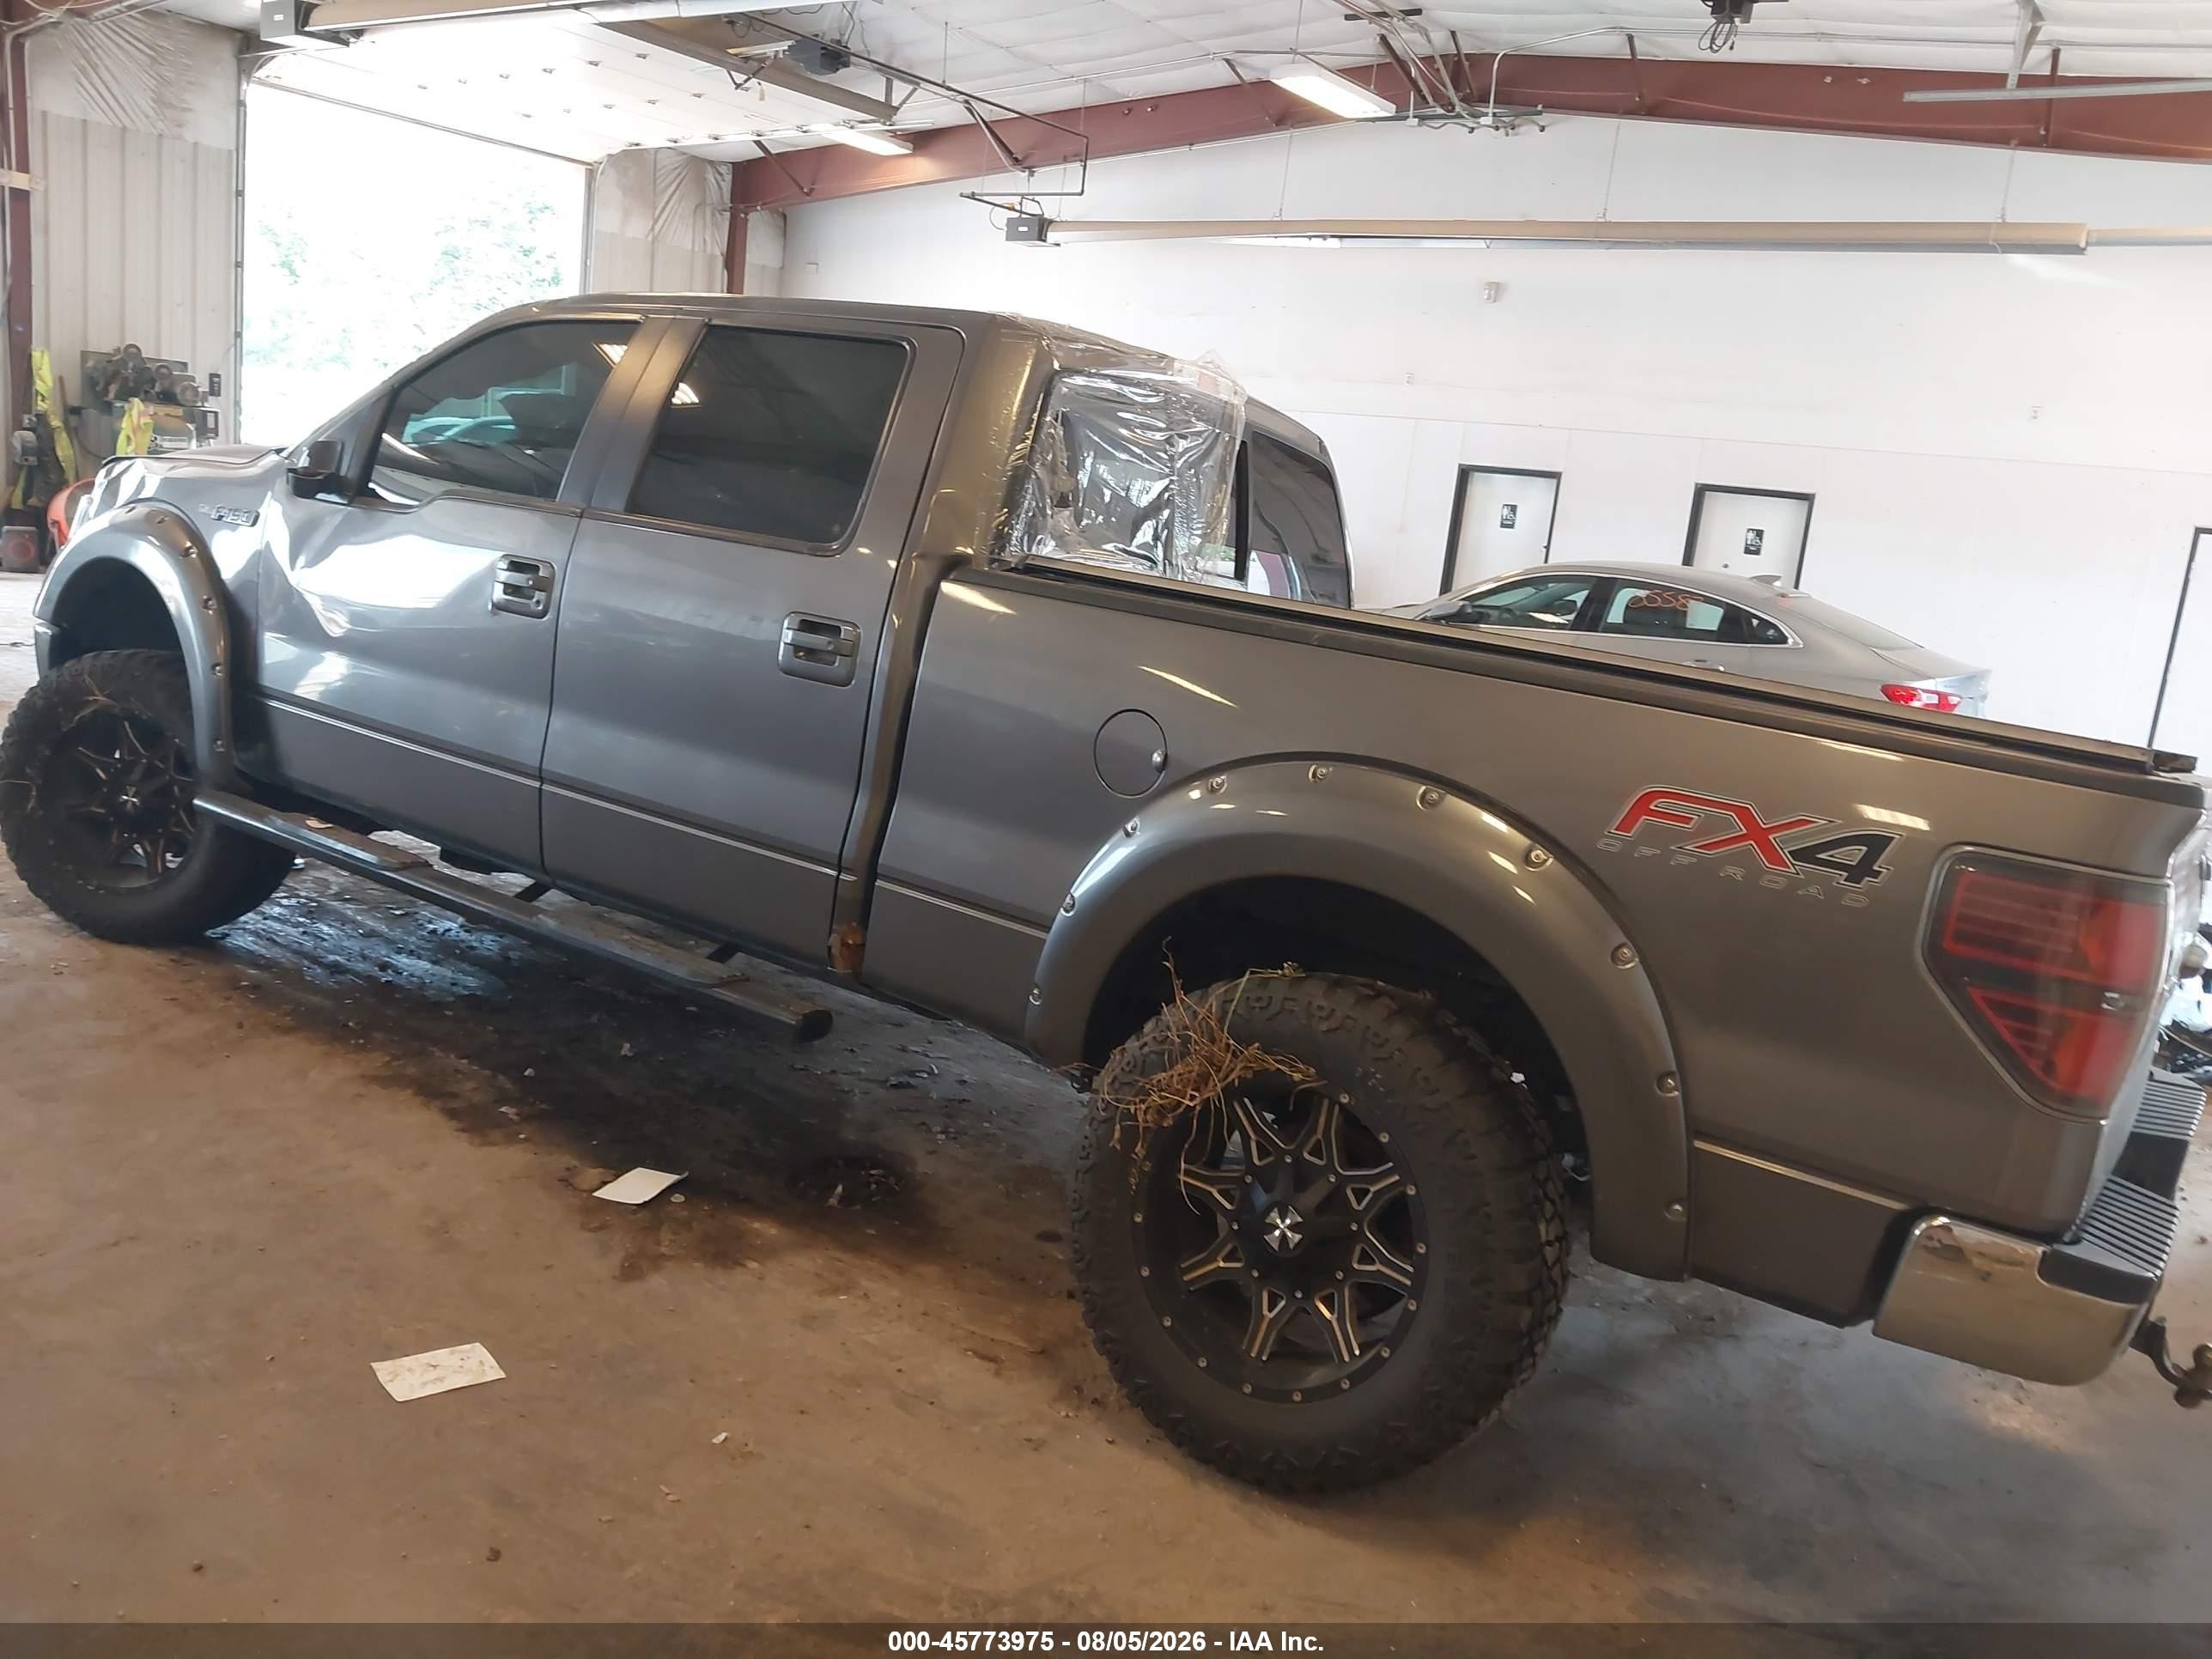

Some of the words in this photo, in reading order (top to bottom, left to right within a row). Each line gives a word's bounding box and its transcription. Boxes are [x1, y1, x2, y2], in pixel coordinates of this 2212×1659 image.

[1596, 837, 1698, 866] OFF
[1719, 865, 1869, 908] ROAD
[1604, 785, 1905, 891] FX4
